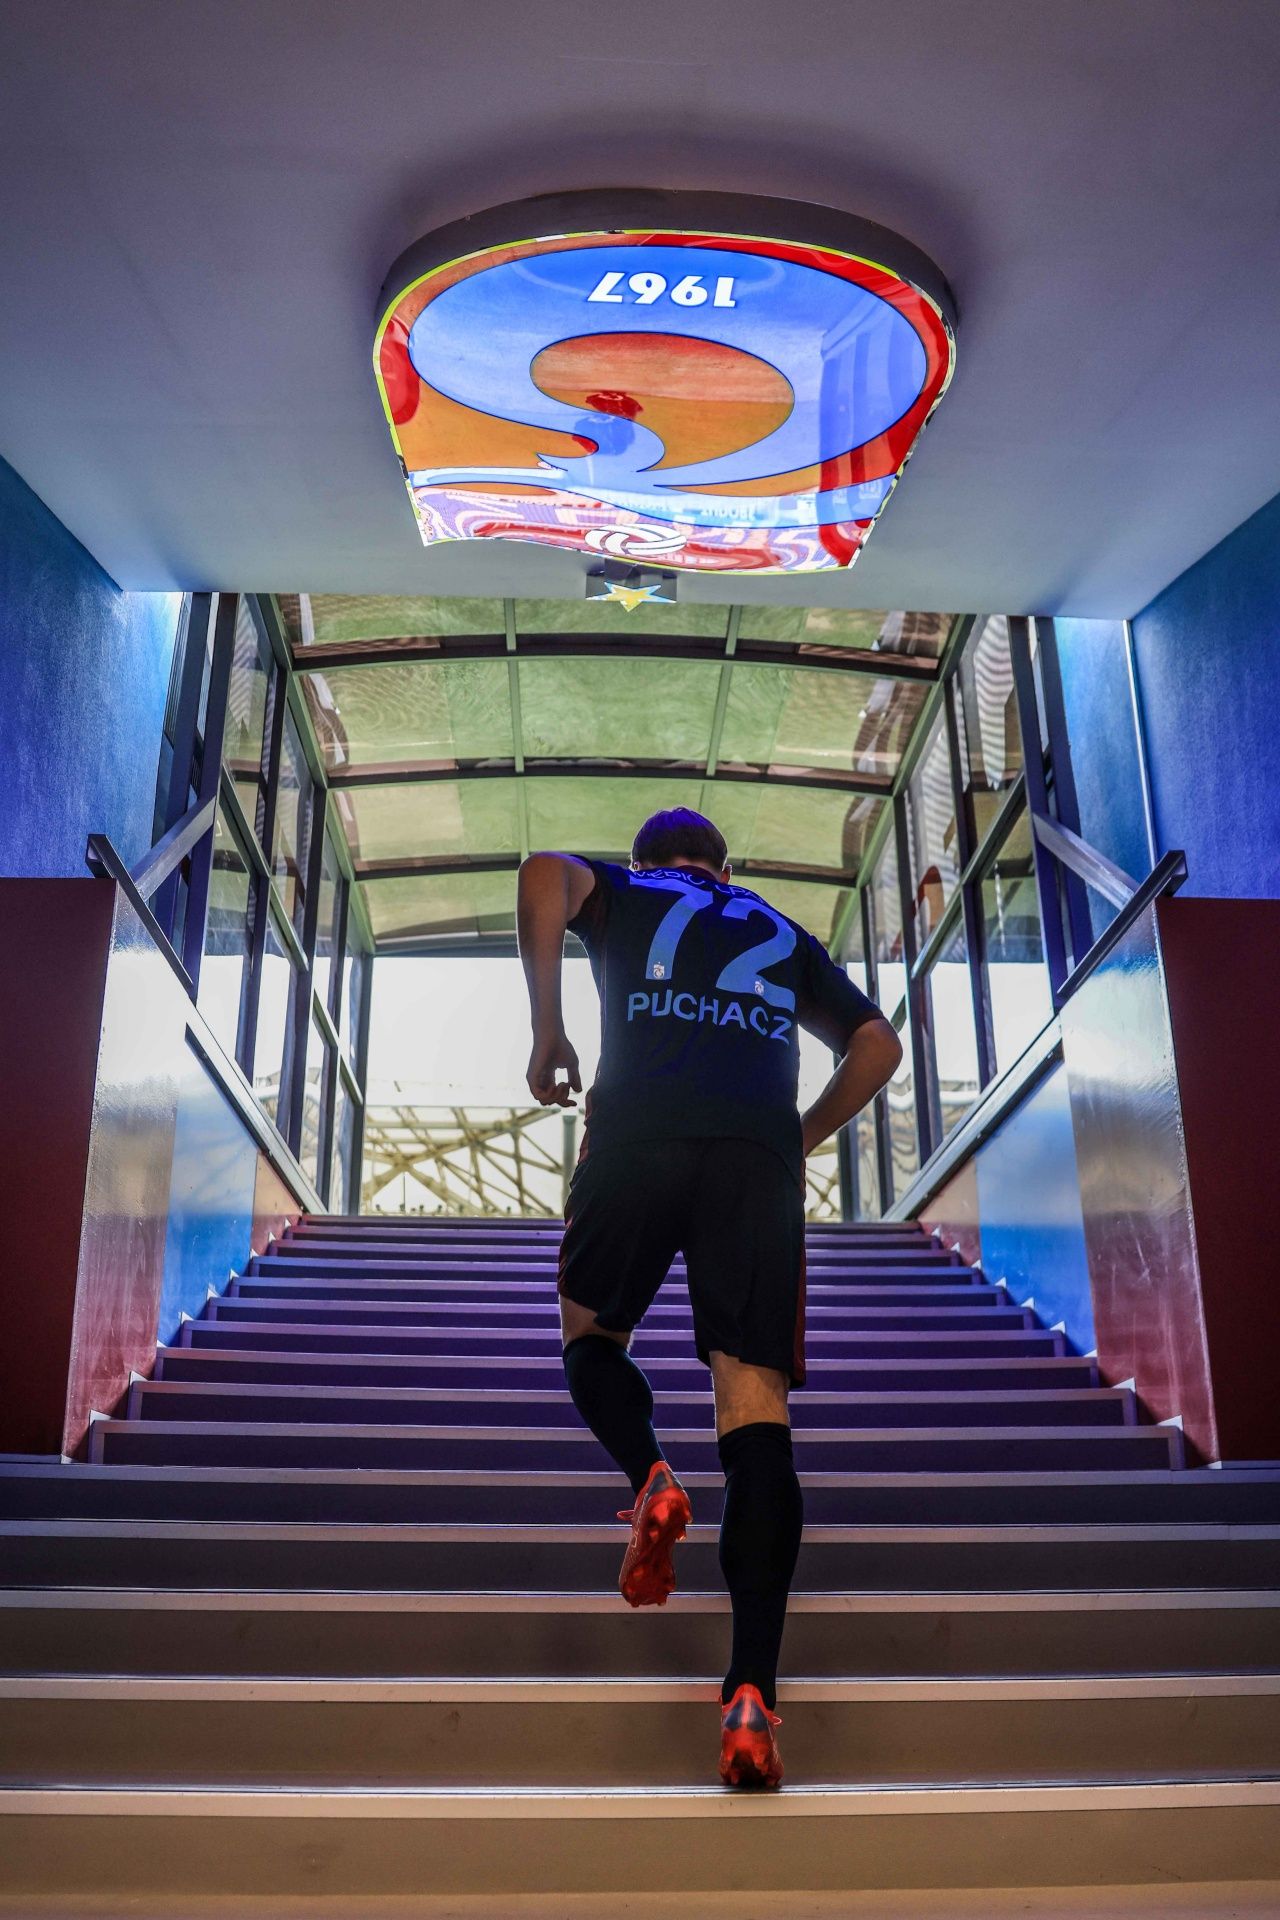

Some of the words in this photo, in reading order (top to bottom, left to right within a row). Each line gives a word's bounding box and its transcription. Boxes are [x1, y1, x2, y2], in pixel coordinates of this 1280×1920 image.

[587, 272, 736, 307] 1967
[629, 875, 797, 1014] 72
[627, 989, 792, 1046] PUCHACZ
